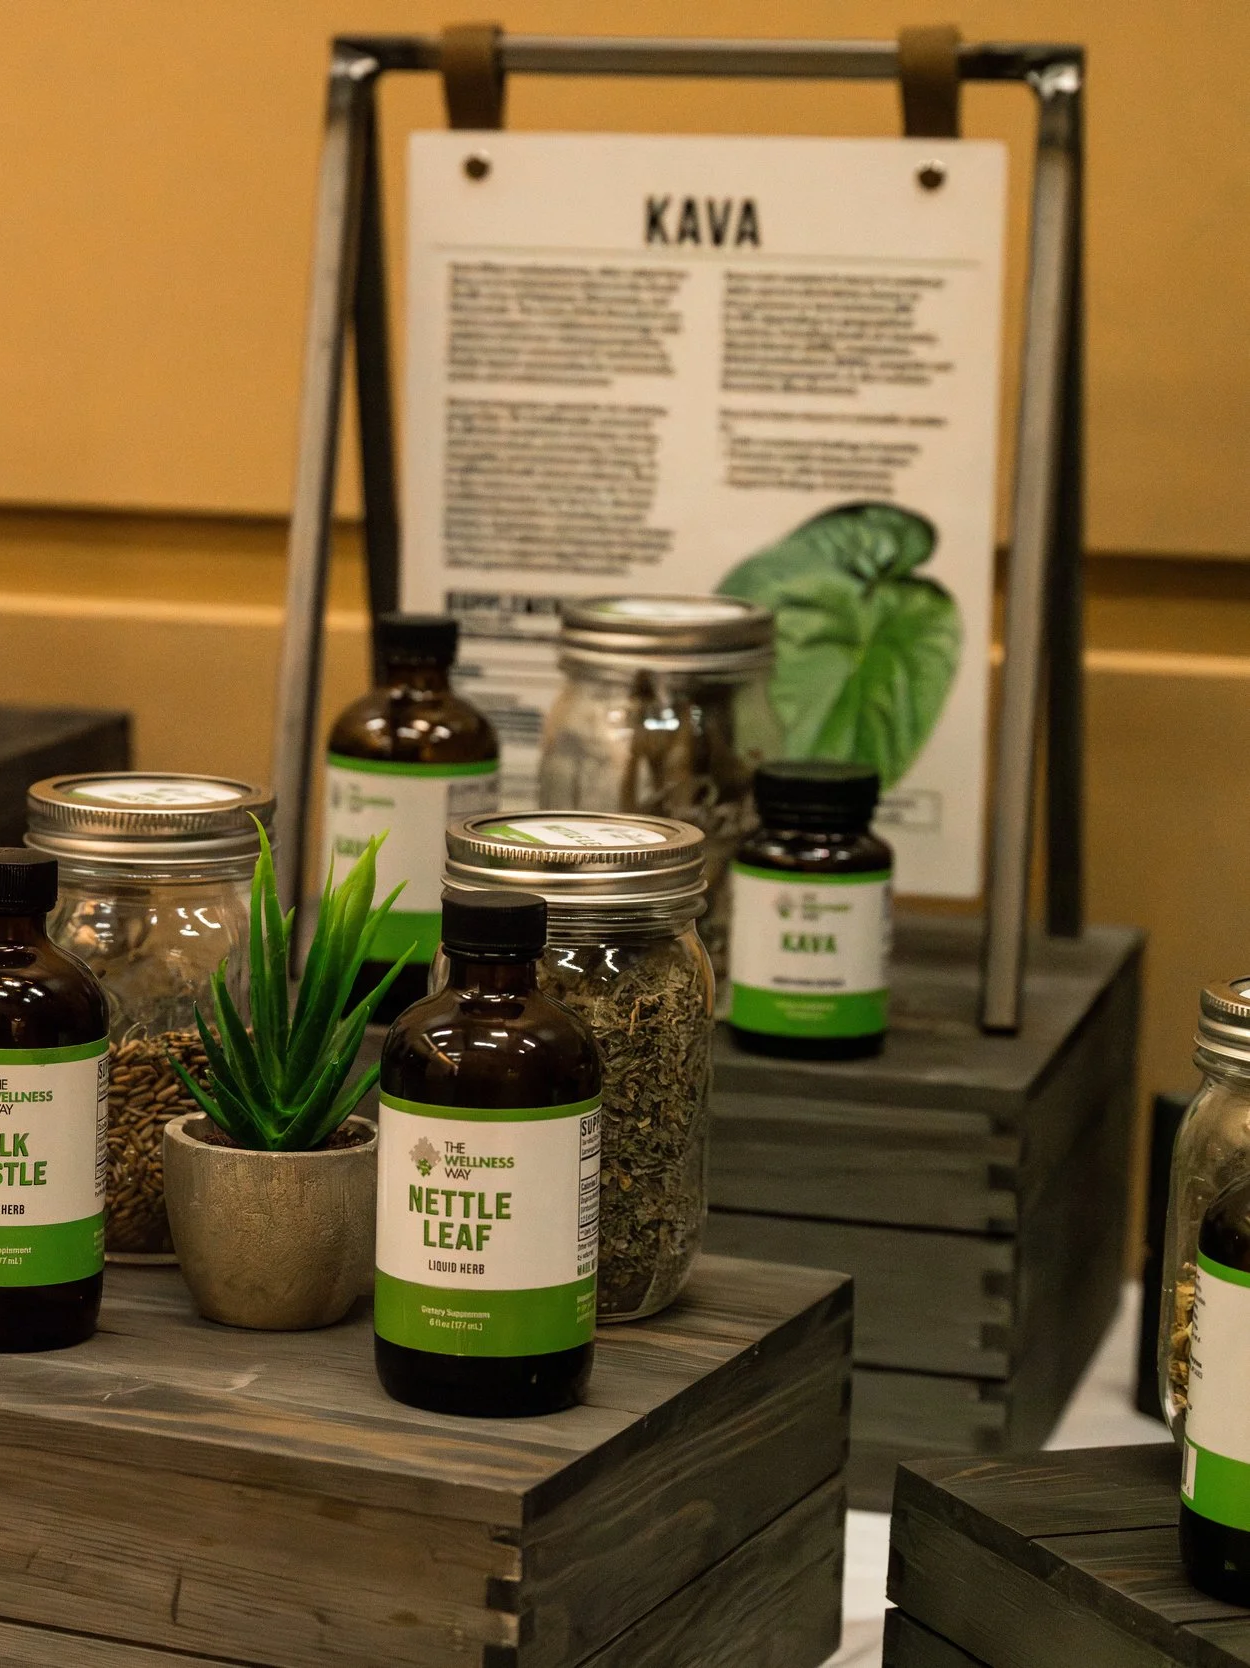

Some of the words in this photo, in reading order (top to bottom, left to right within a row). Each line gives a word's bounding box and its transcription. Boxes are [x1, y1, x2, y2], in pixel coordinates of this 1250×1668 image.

[644, 195, 762, 247] KAVA
[445, 1141, 465, 1154] THE
[445, 1155, 514, 1168] WELLNESS
[445, 1168, 472, 1180] WAY
[409, 1184, 512, 1219] NETTLE
[1, 1205, 25, 1215] HERB
[423, 1219, 492, 1251] LEAF
[428, 1260, 457, 1274] LIQUID
[460, 1261, 485, 1275] HERB
